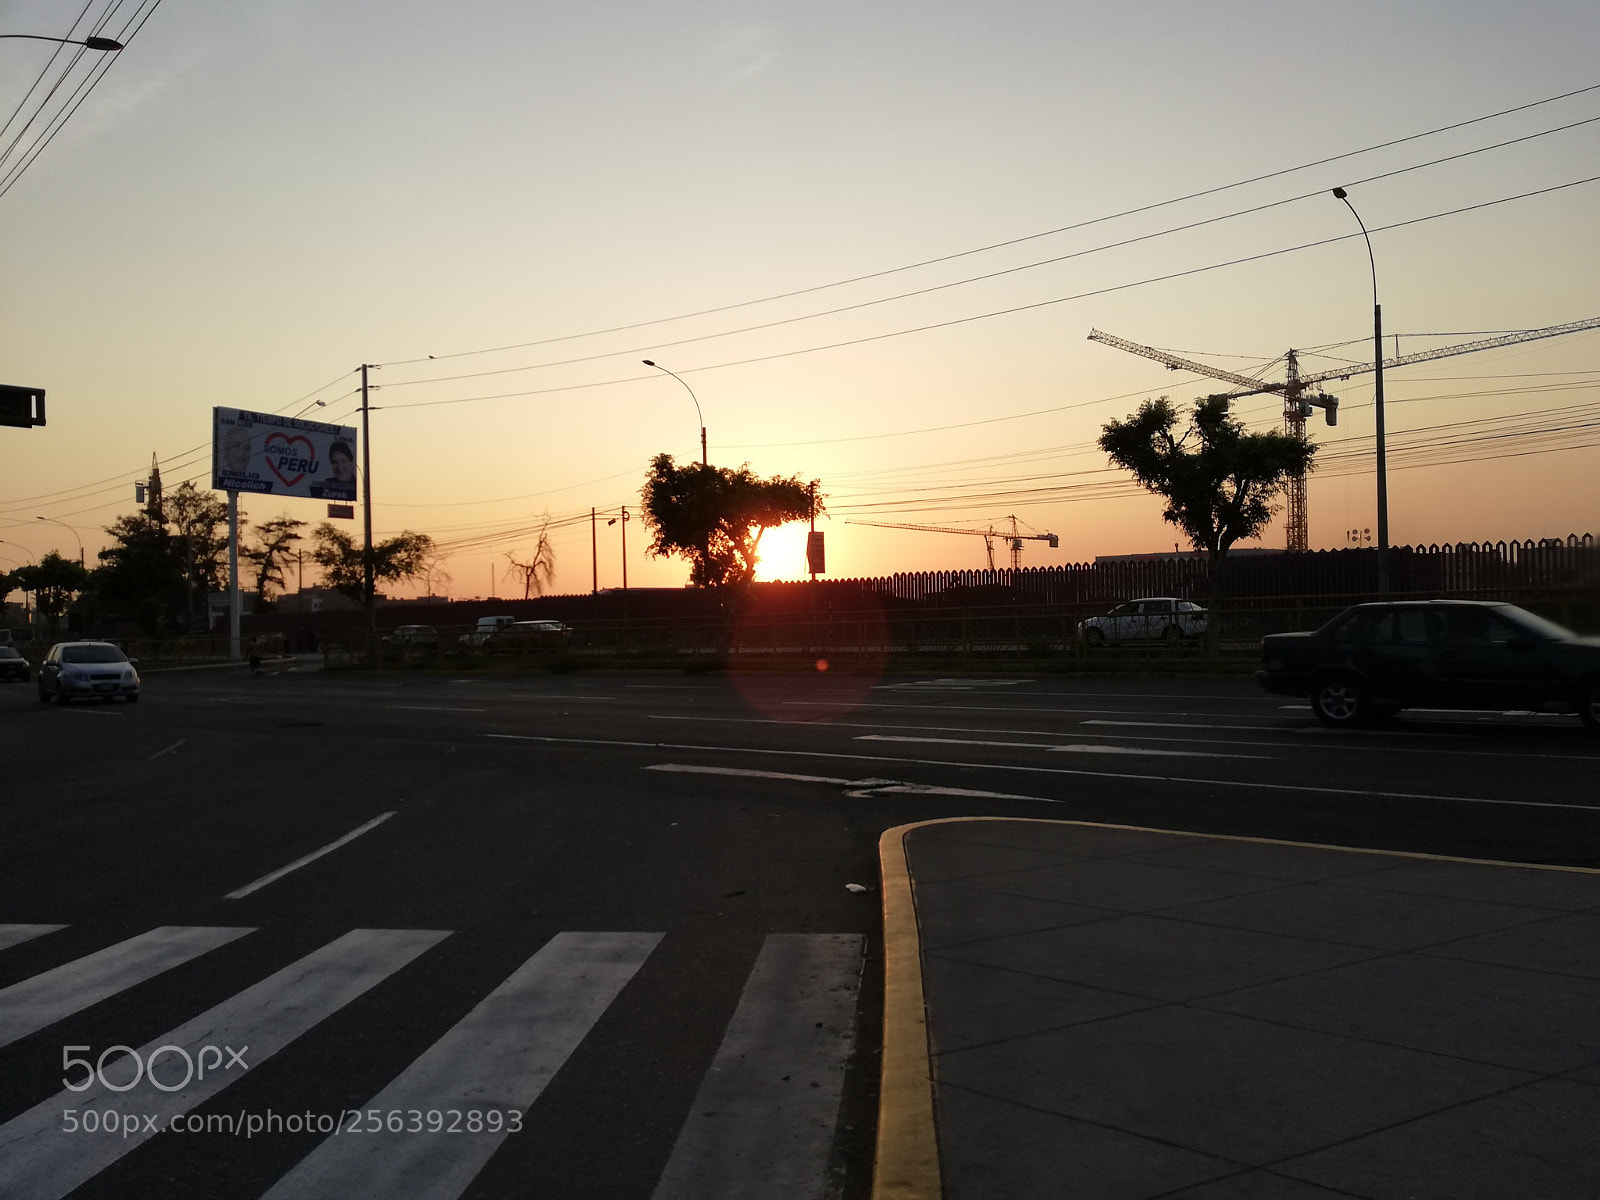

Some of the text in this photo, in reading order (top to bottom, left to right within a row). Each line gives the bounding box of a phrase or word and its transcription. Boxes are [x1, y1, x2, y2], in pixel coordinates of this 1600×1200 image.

[221, 418, 235, 426] SAN
[335, 435, 353, 443] LIMA
[264, 444, 298, 457] SOMOS
[278, 456, 320, 474] PERU
[222, 469, 260, 480] EMILIO
[222, 478, 266, 490] Nicolich
